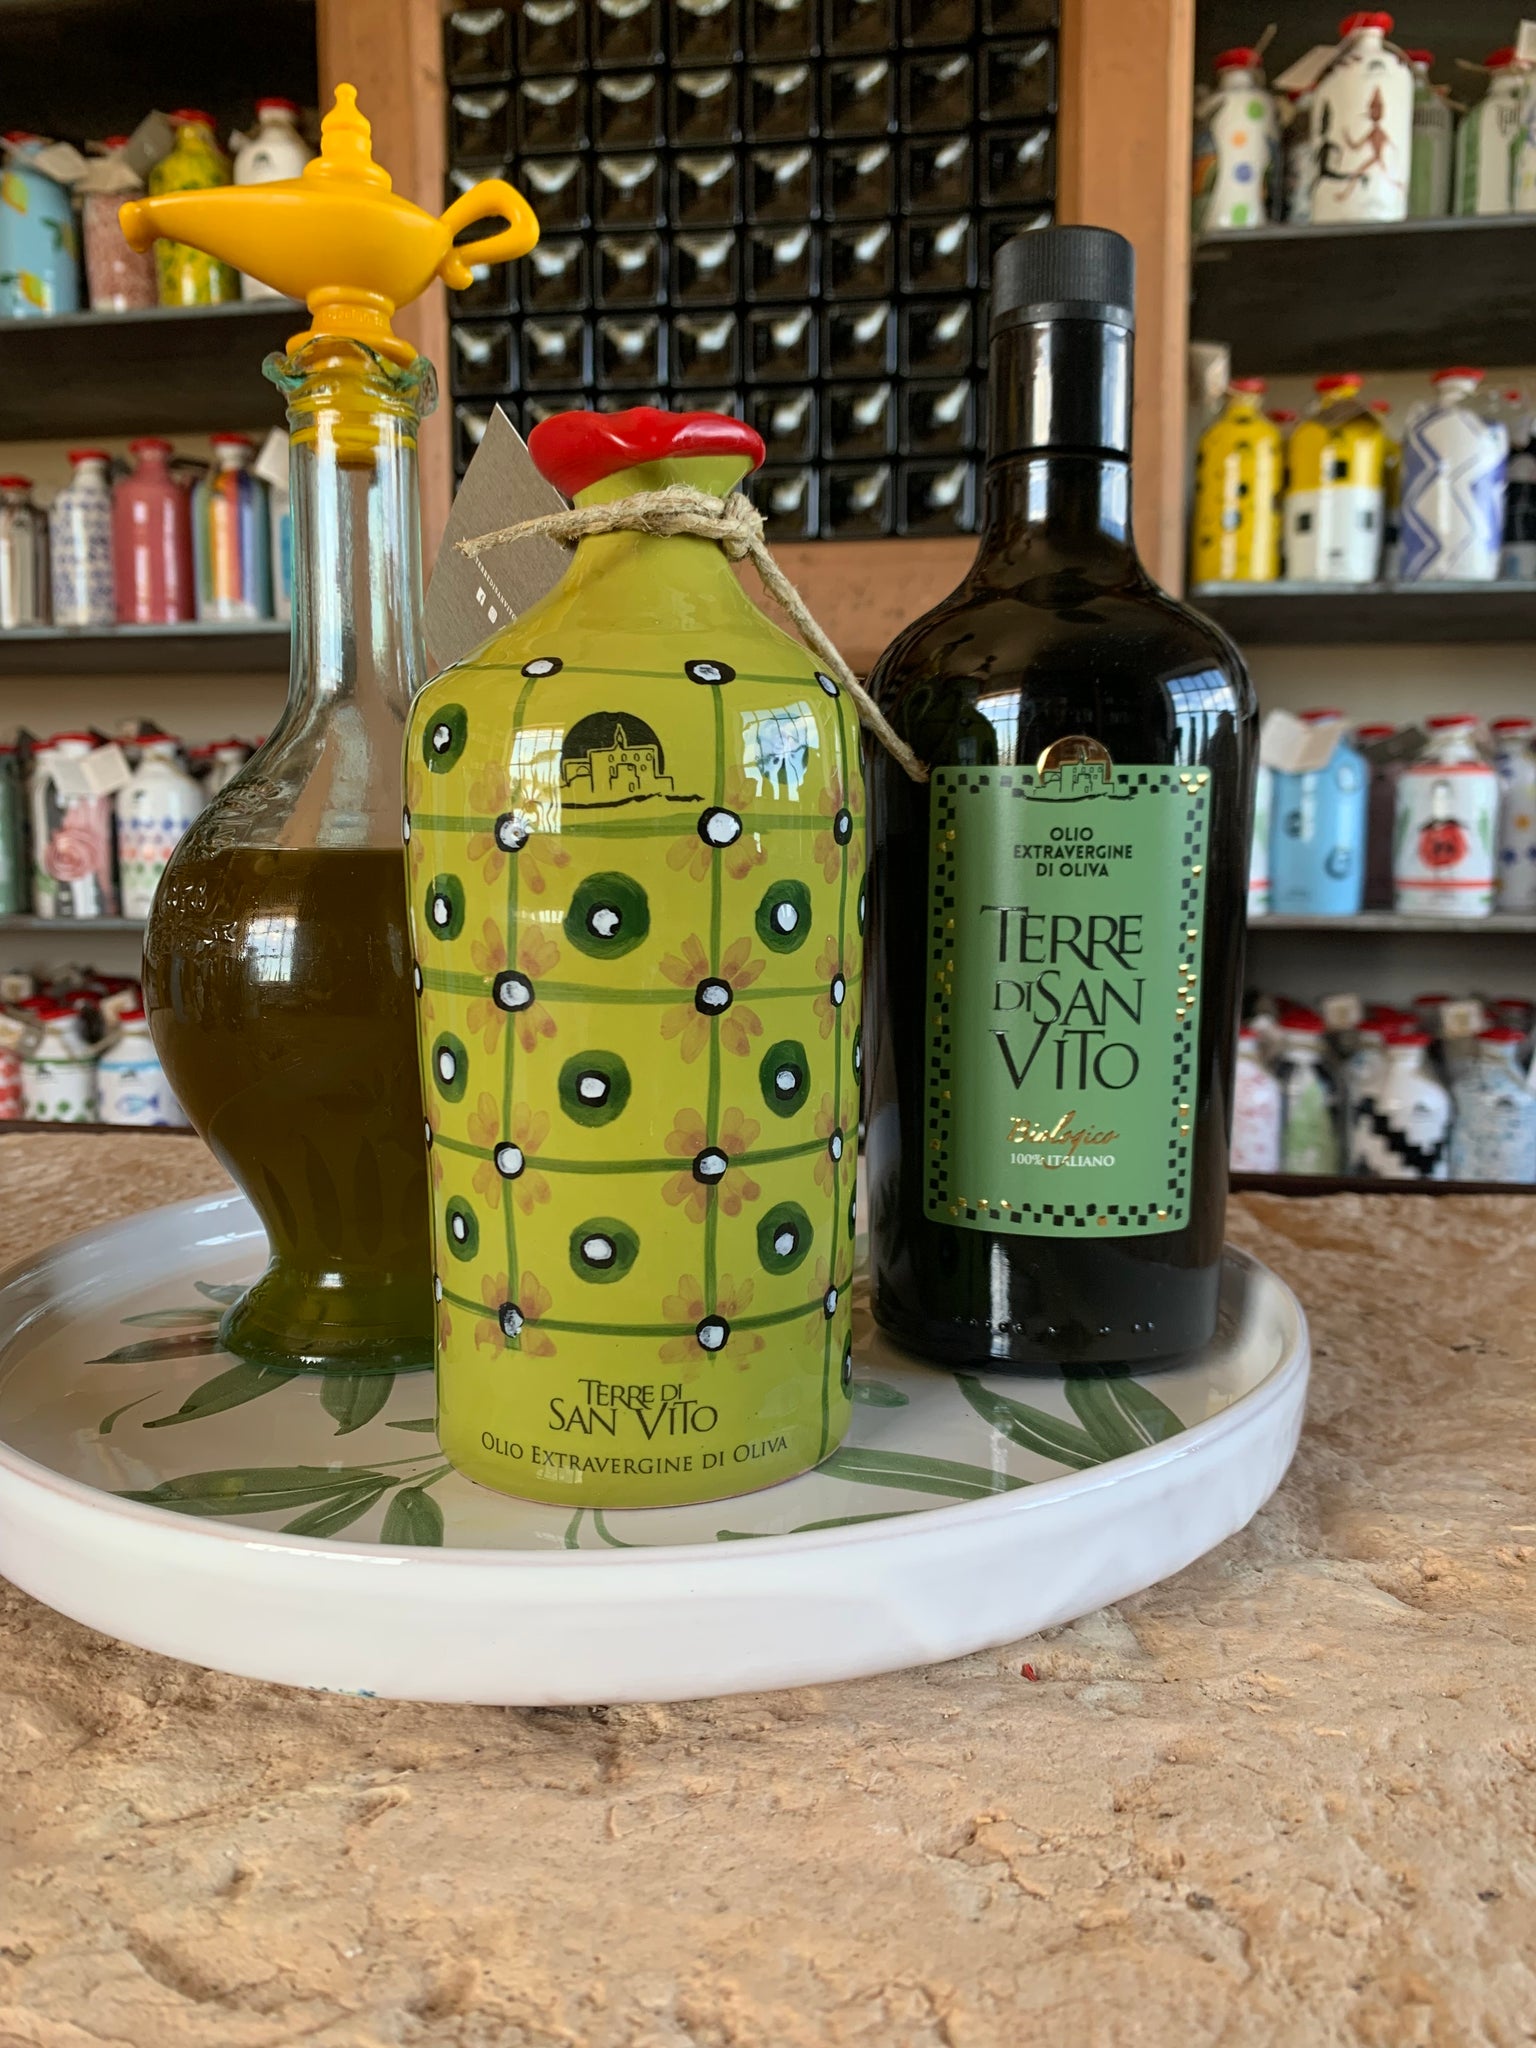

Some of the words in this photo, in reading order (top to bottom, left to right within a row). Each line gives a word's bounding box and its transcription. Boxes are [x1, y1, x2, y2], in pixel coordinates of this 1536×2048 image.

[1050, 827, 1093, 841] OLIO
[1013, 845, 1133, 859] EXTRAVERGINE
[1036, 862, 1053, 877] DI
[1059, 862, 1109, 877] OLIVA
[980, 905, 1144, 971] TERRE
[993, 979, 1034, 1012] DI
[1033, 969, 1147, 1026] SAN
[988, 1022, 1140, 1091] VITO
[1007, 1110, 1120, 1170] Biologico
[1010, 1152, 1042, 1166] 100%
[1047, 1154, 1116, 1168] ITALIANO
[578, 1378, 655, 1410] TERRE
[661, 1383, 683, 1401] DI
[549, 1397, 617, 1436] SAN
[636, 1400, 718, 1440] VITO
[702, 1452, 725, 1470] DI
